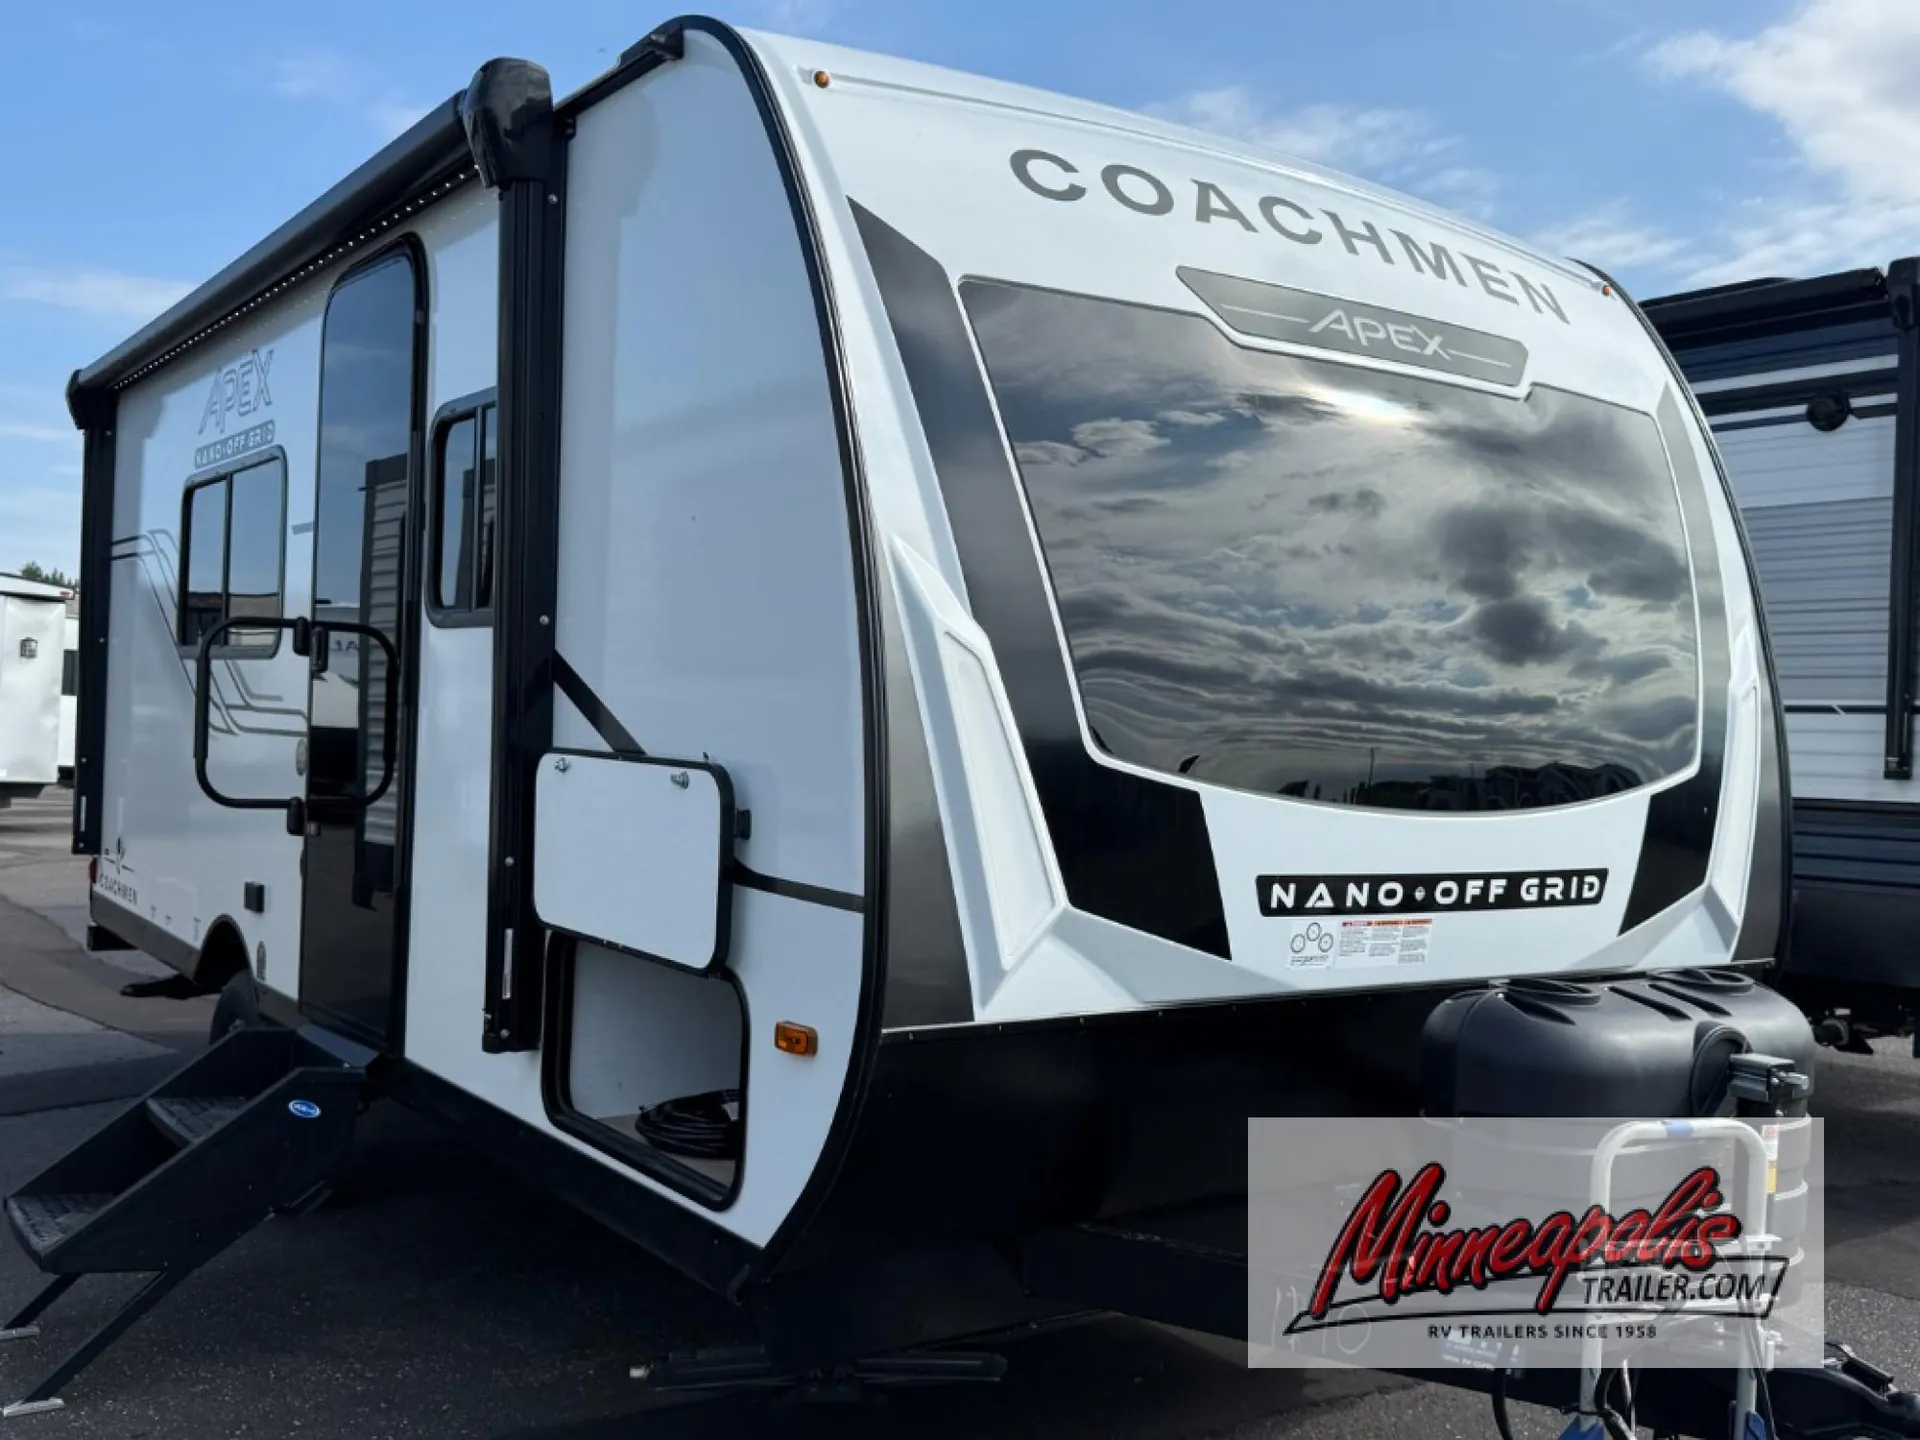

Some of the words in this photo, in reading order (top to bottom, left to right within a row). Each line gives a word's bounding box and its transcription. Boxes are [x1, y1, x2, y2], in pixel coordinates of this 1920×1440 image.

[1009, 148, 1571, 325] COACHMEN
[1308, 308, 1452, 361] APEX
[198, 347, 275, 435] APEX
[1269, 881, 1404, 909] NANO
[1433, 878, 1508, 905] OFF
[1519, 874, 1602, 902] GRID
